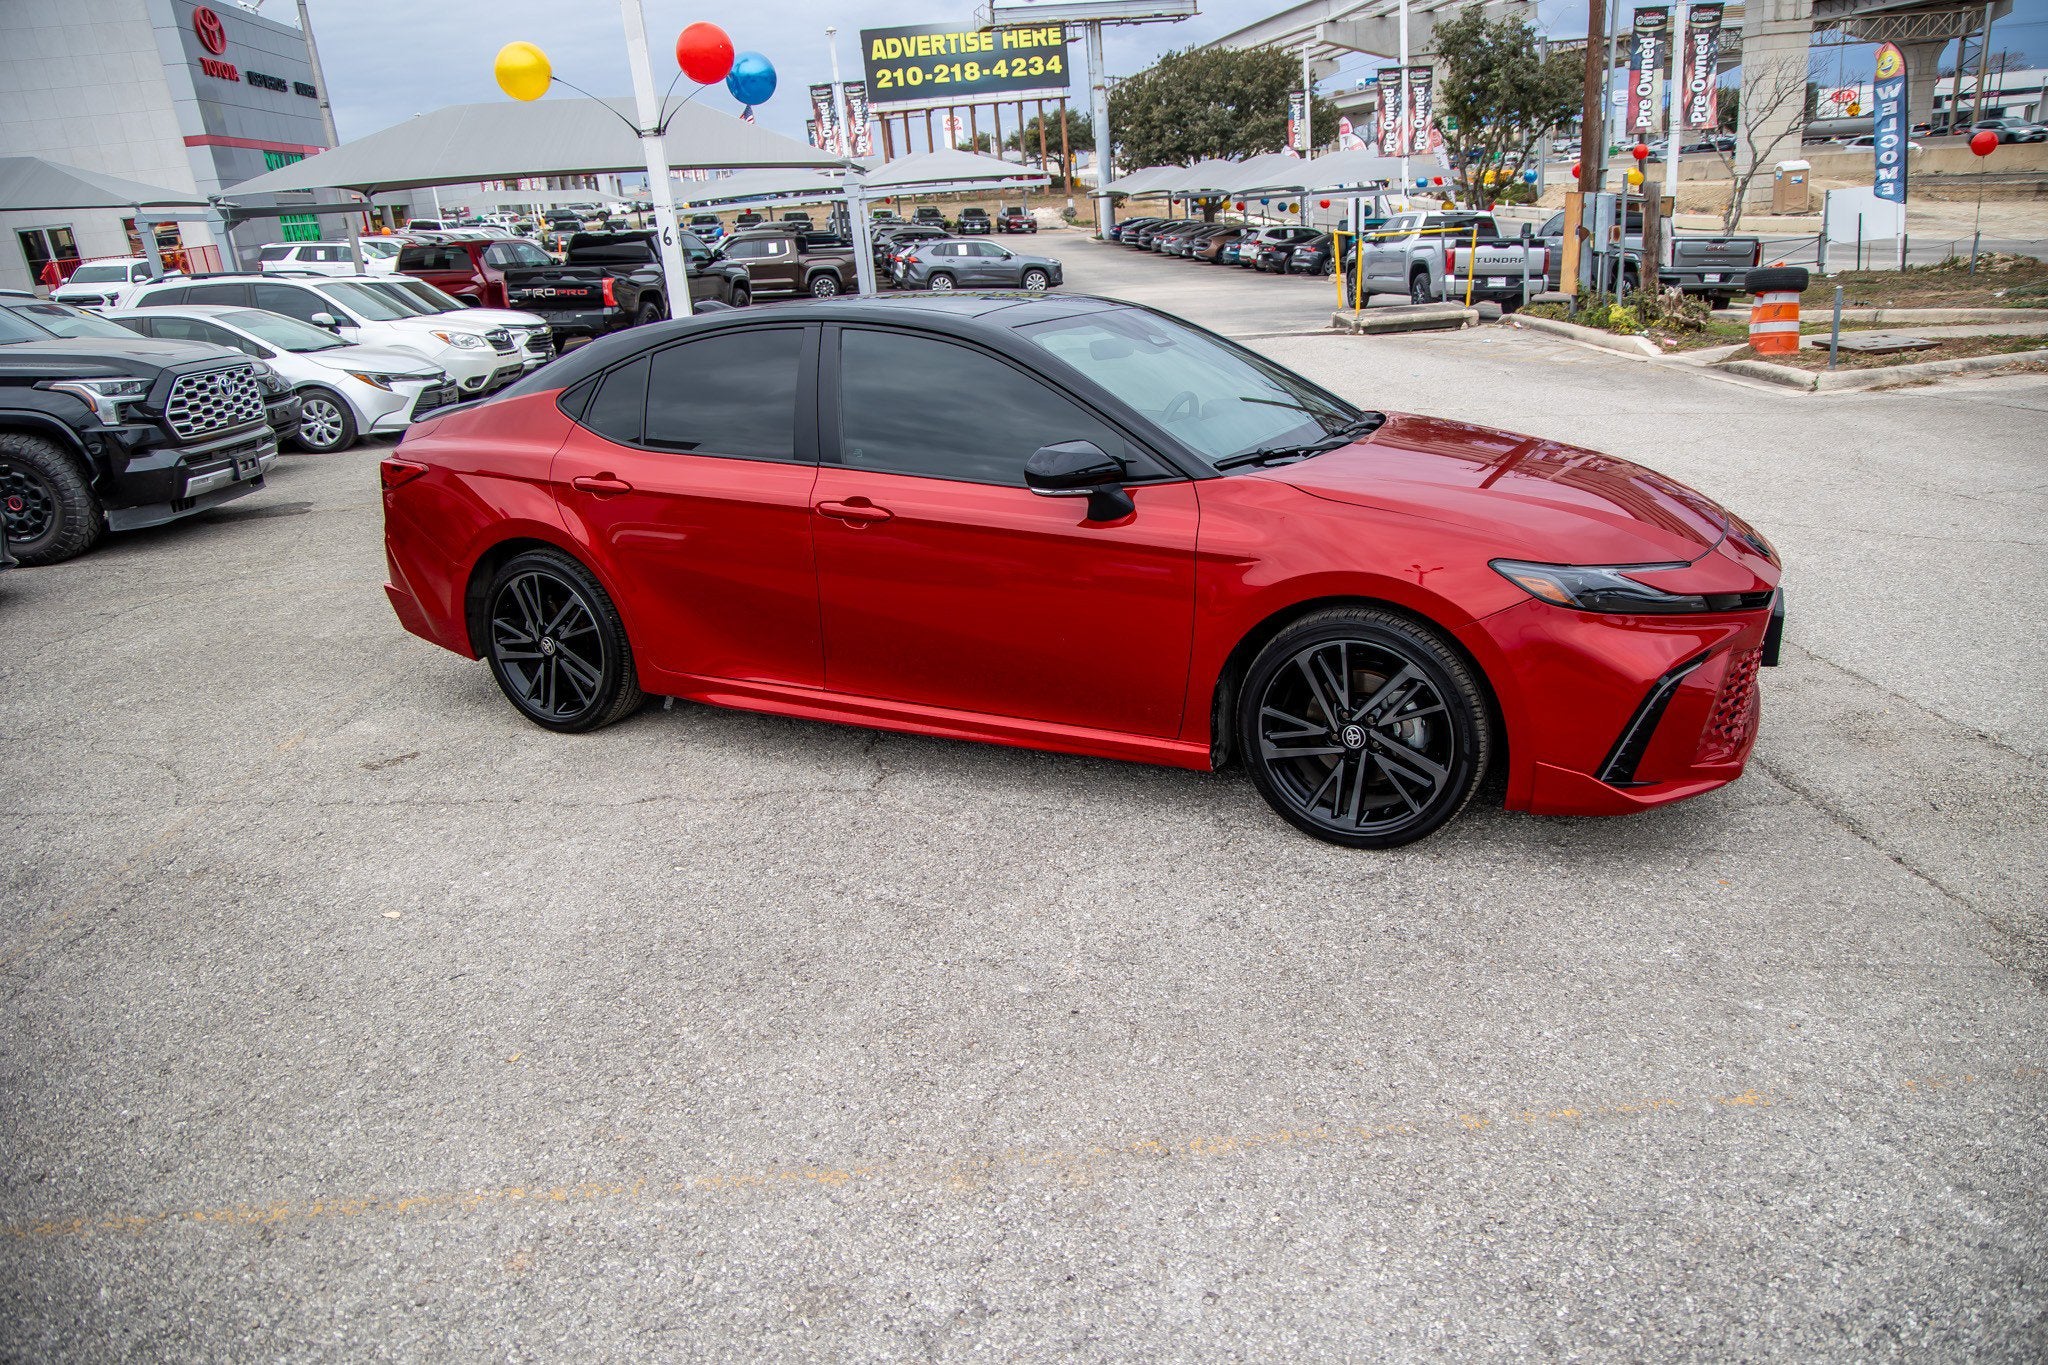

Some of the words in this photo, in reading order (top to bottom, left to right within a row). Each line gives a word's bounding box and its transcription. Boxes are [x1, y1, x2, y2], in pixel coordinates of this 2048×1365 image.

[871, 31, 994, 61] ADVERTISE
[1002, 27, 1062, 50] HERE
[199, 57, 240, 82] TOYOTA
[875, 54, 1063, 89] 210-218-4234
[1636, 37, 1656, 97] Owned
[1690, 33, 1710, 92] Owned
[817, 102, 833, 138] Owned
[850, 99, 865, 134] Owned
[1382, 88, 1395, 130] Owned
[1413, 86, 1425, 128] Owned
[1636, 99, 1652, 127] Pre
[1690, 95, 1707, 123] Pre
[856, 136, 867, 153] Pre
[1384, 132, 1396, 152] Pre
[1414, 130, 1426, 150] Pre
[663, 226, 672, 246] 6
